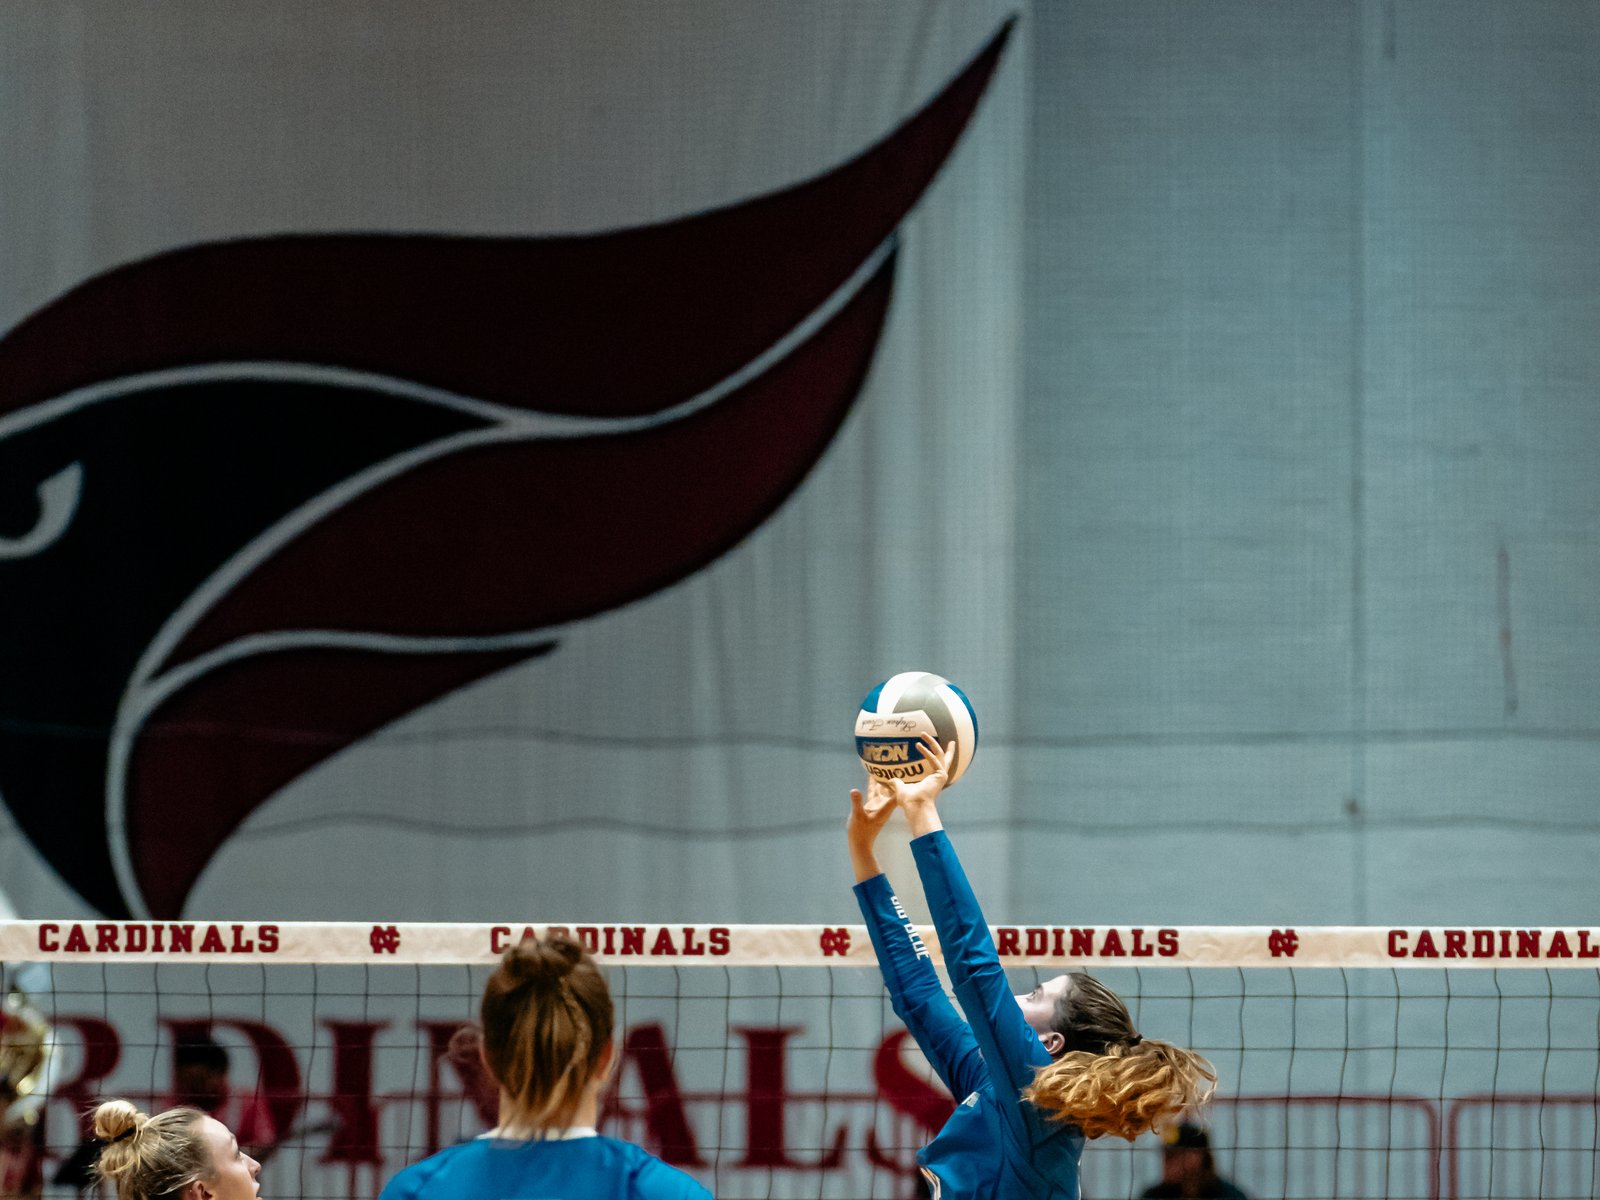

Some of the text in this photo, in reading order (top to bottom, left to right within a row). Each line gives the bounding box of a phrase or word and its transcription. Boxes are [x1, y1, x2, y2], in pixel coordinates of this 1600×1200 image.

[864, 763, 924, 780] molten
[38, 923, 280, 954] CARDINALS
[997, 928, 1180, 957] RDINALS
[1387, 929, 1600, 958] CARDINAL
